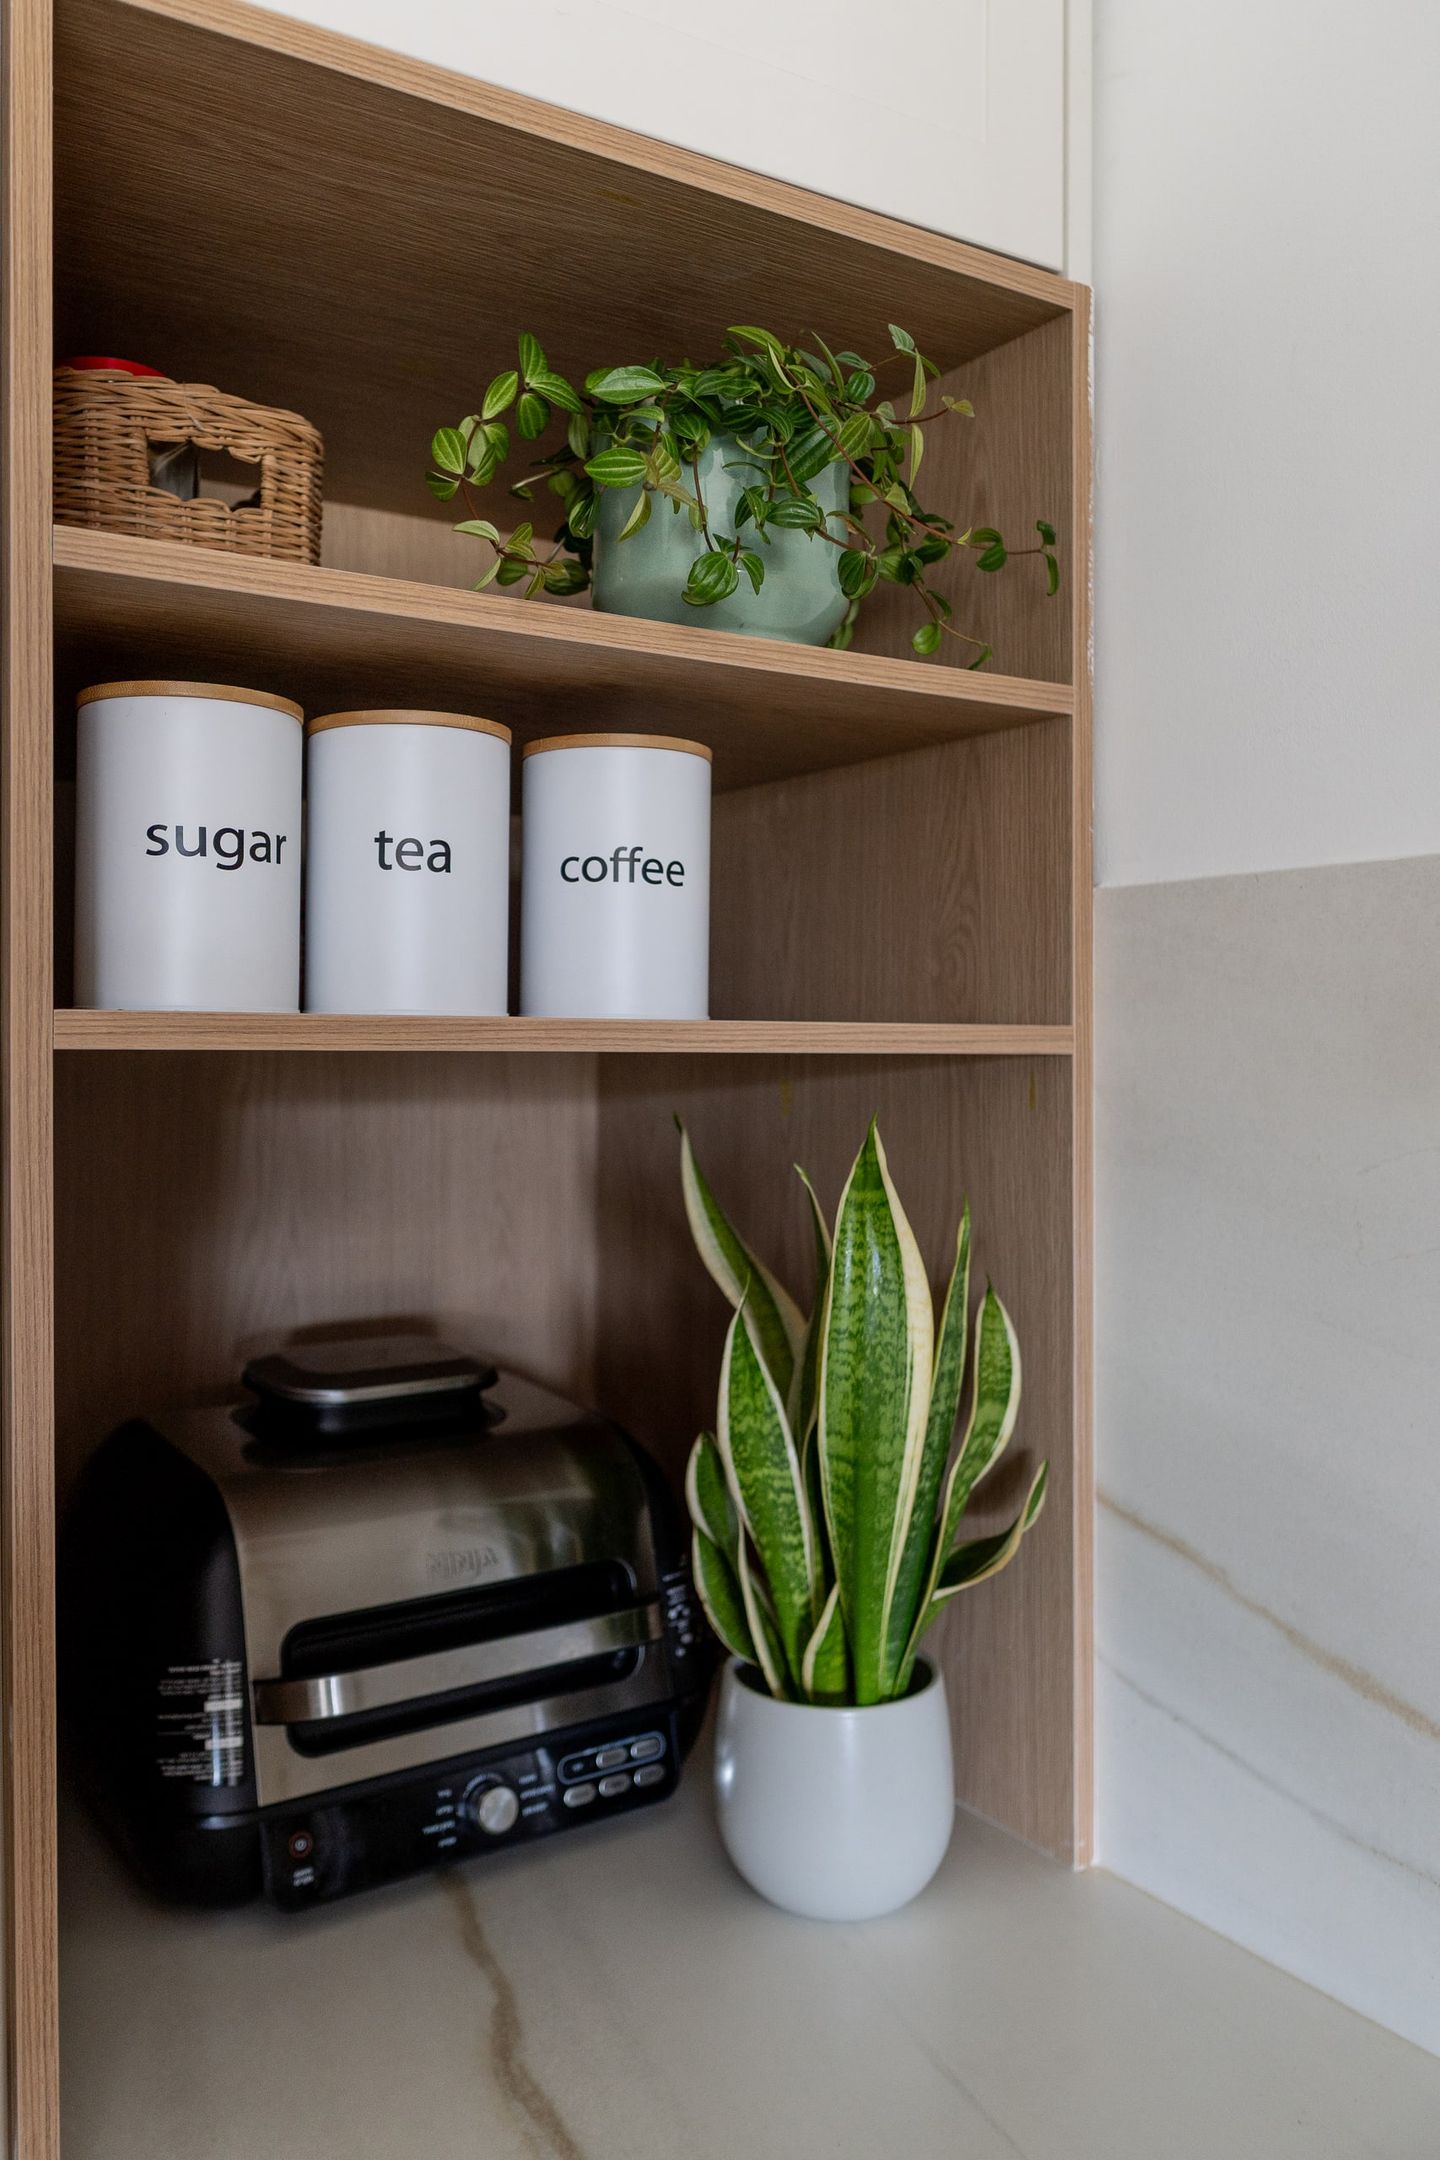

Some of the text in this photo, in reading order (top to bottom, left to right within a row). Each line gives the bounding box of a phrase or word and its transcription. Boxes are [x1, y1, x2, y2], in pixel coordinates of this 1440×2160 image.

[145, 823, 287, 871] sugar
[373, 829, 452, 874] tea
[559, 846, 685, 887] coffee
